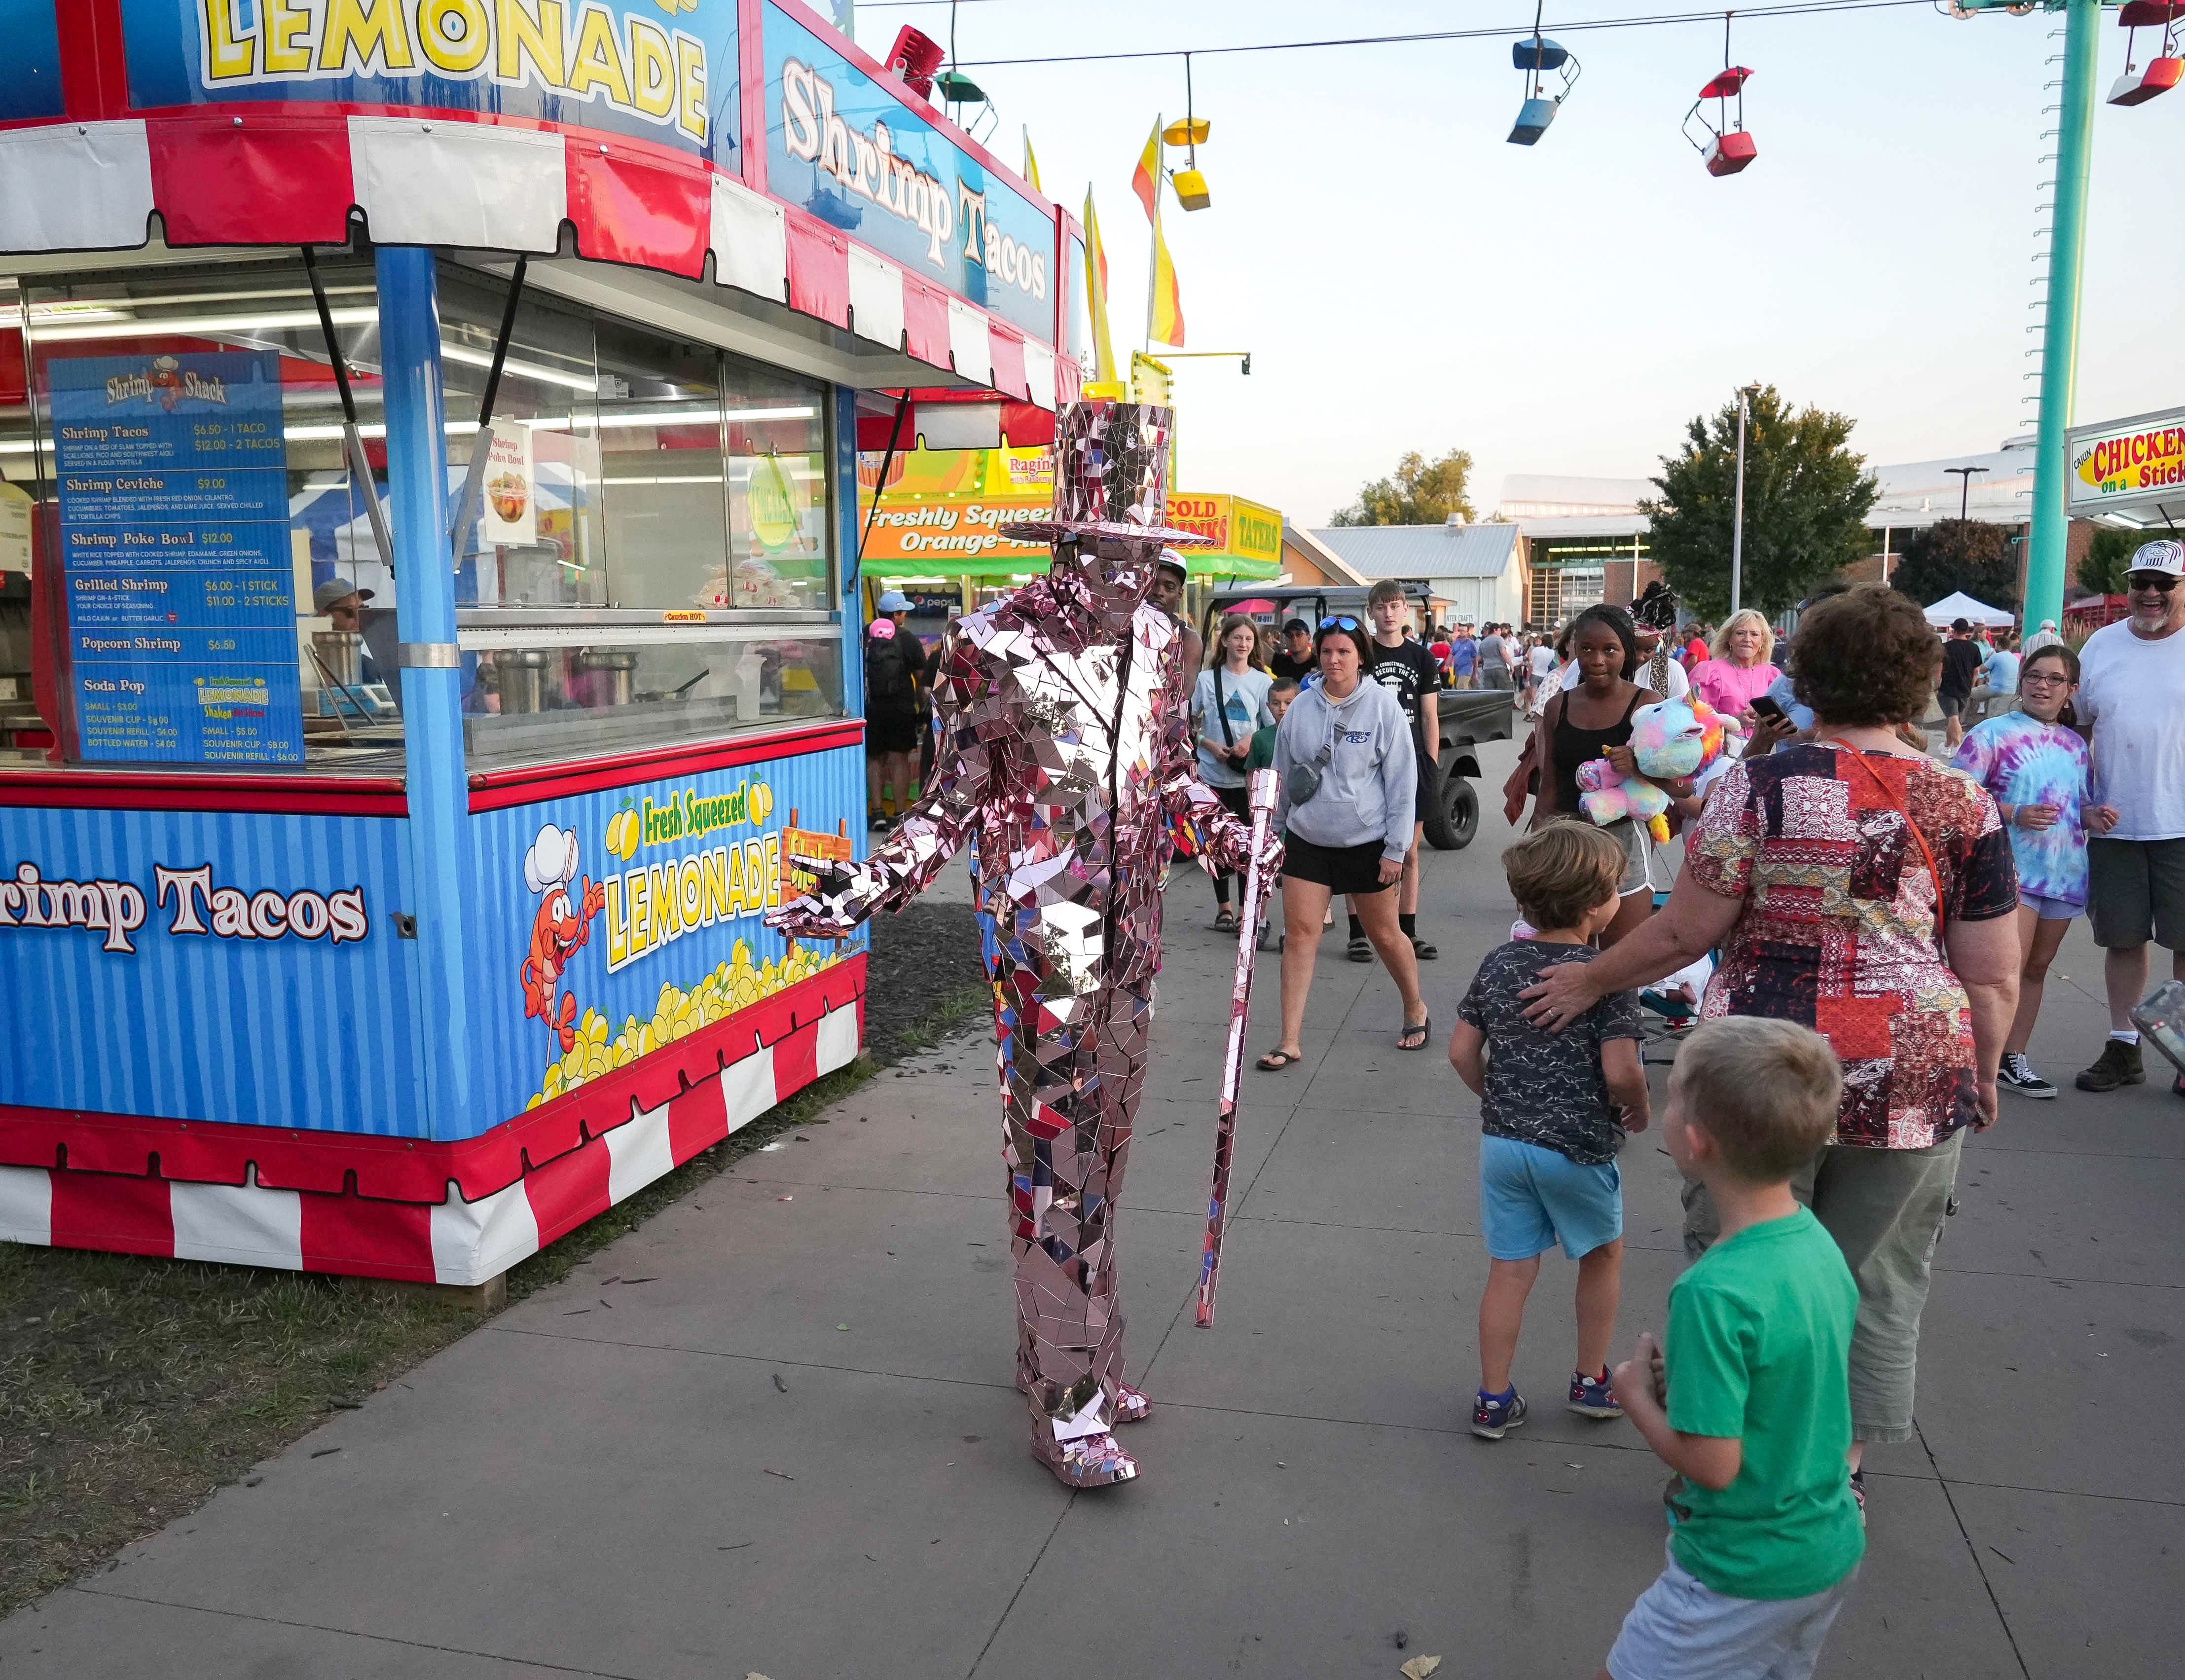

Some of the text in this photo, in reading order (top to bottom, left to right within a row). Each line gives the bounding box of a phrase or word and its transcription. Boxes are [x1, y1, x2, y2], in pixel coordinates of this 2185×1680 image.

[203, 0, 707, 143] LEMONADE
[782, 59, 1046, 302] Shrimp Tacos
[107, 370, 226, 404] Shrimp Shack
[62, 426, 148, 441] Shrimp Tacos
[194, 424, 221, 436] $6.50
[237, 423, 265, 433] TACO
[195, 438, 280, 450] $12.00 2 TACOS
[493, 437, 517, 452] Shrimp
[488, 451, 525, 466] Poke Bowl
[2074, 448, 2092, 470] CAJUN
[67, 477, 163, 493] Shrimp Ceviche
[198, 479, 225, 489] $9.00
[2102, 480, 2116, 493] on
[2120, 478, 2127, 490] a
[1165, 500, 1216, 517] COLD
[864, 506, 959, 531] Freshly
[72, 532, 194, 548] Shrimp Poke Bowl
[202, 533, 233, 544] $12.00
[1238, 514, 1277, 553] TATERS
[75, 579, 168, 593] Grilled Shrimp
[205, 581, 233, 591] $6.00
[249, 581, 277, 591] STICK
[207, 596, 289, 607] $11.00 2 STICKS
[927, 597, 955, 608] pepsi
[81, 637, 181, 653] Popcorn Shrimp
[209, 640, 235, 650] $6.50
[1398, 668, 1409, 677] THE
[84, 679, 145, 695] Soda Pop
[198, 688, 268, 705] LEMONADE
[205, 705, 232, 719] Shaken
[236, 727, 257, 735] $5.00
[643, 781, 746, 842] Fresh Squeezed
[153, 862, 368, 944] Tacos
[606, 834, 779, 970] LEMONADE
